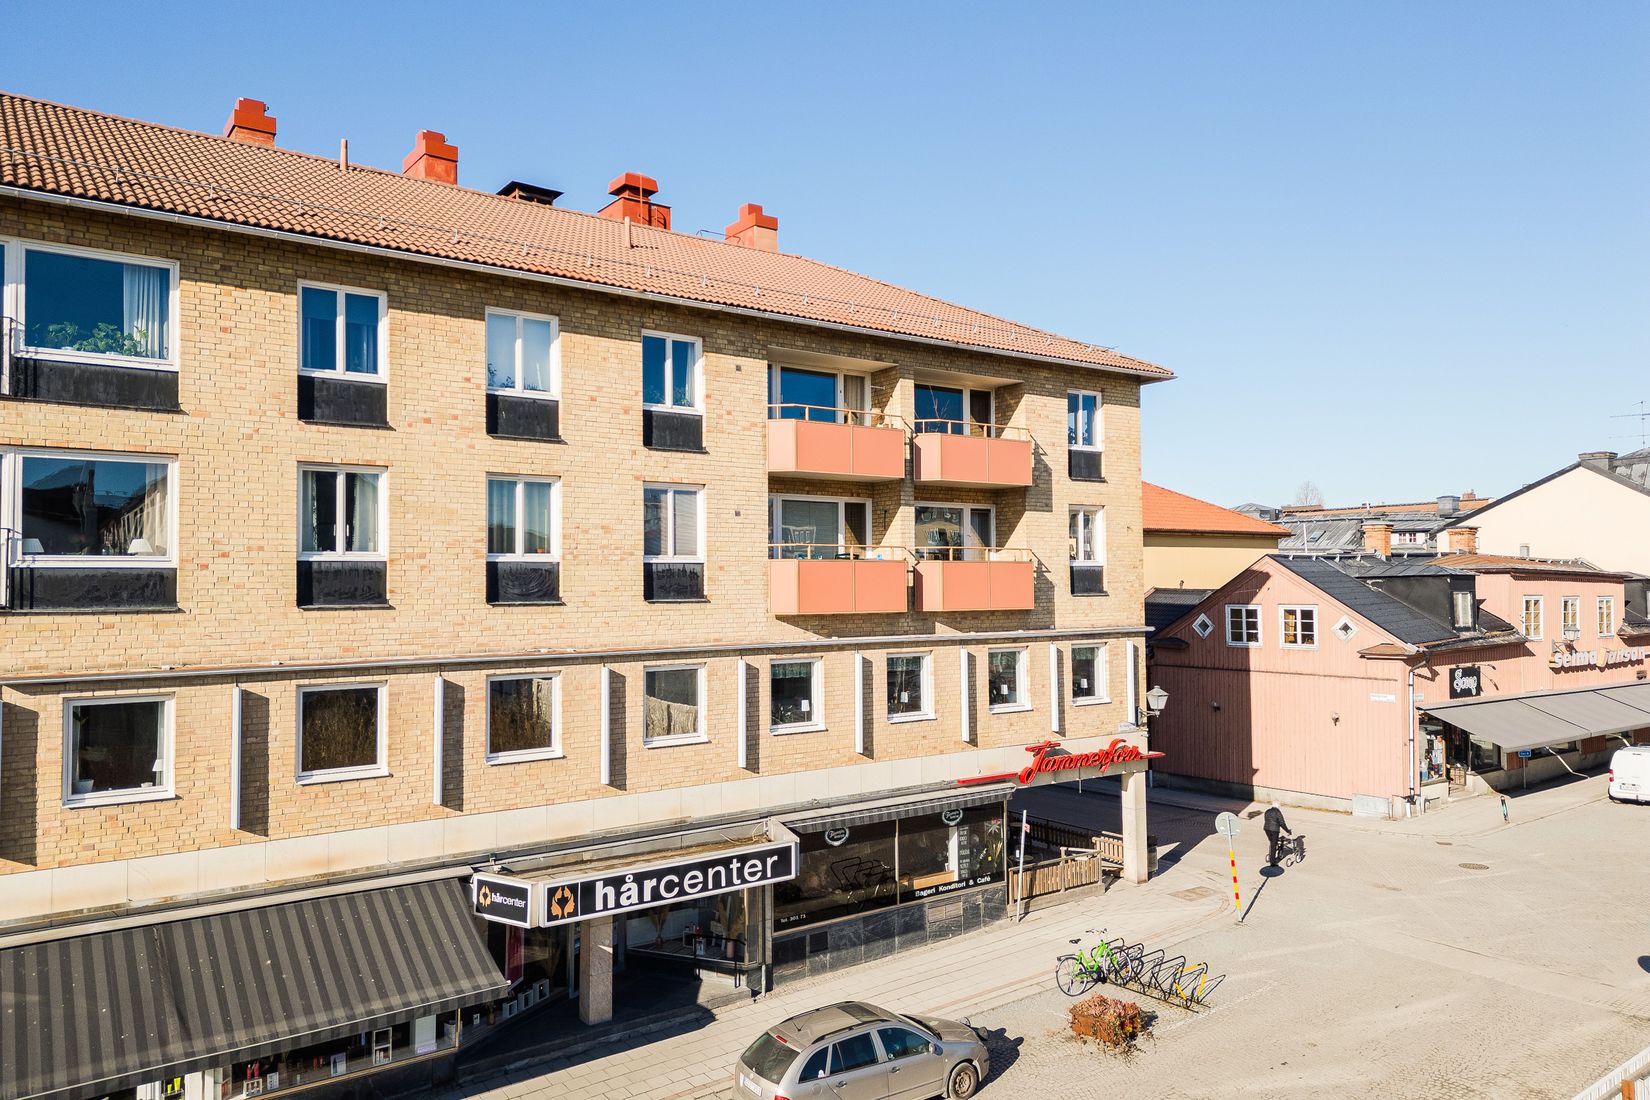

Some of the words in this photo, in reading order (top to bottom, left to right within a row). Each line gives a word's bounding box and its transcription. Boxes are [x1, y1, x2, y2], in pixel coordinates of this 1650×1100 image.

[595, 855, 778, 911] hårcenter
[939, 882, 966, 892] Konditori
[977, 875, 991, 884] Café
[491, 892, 527, 908] hårcenter
